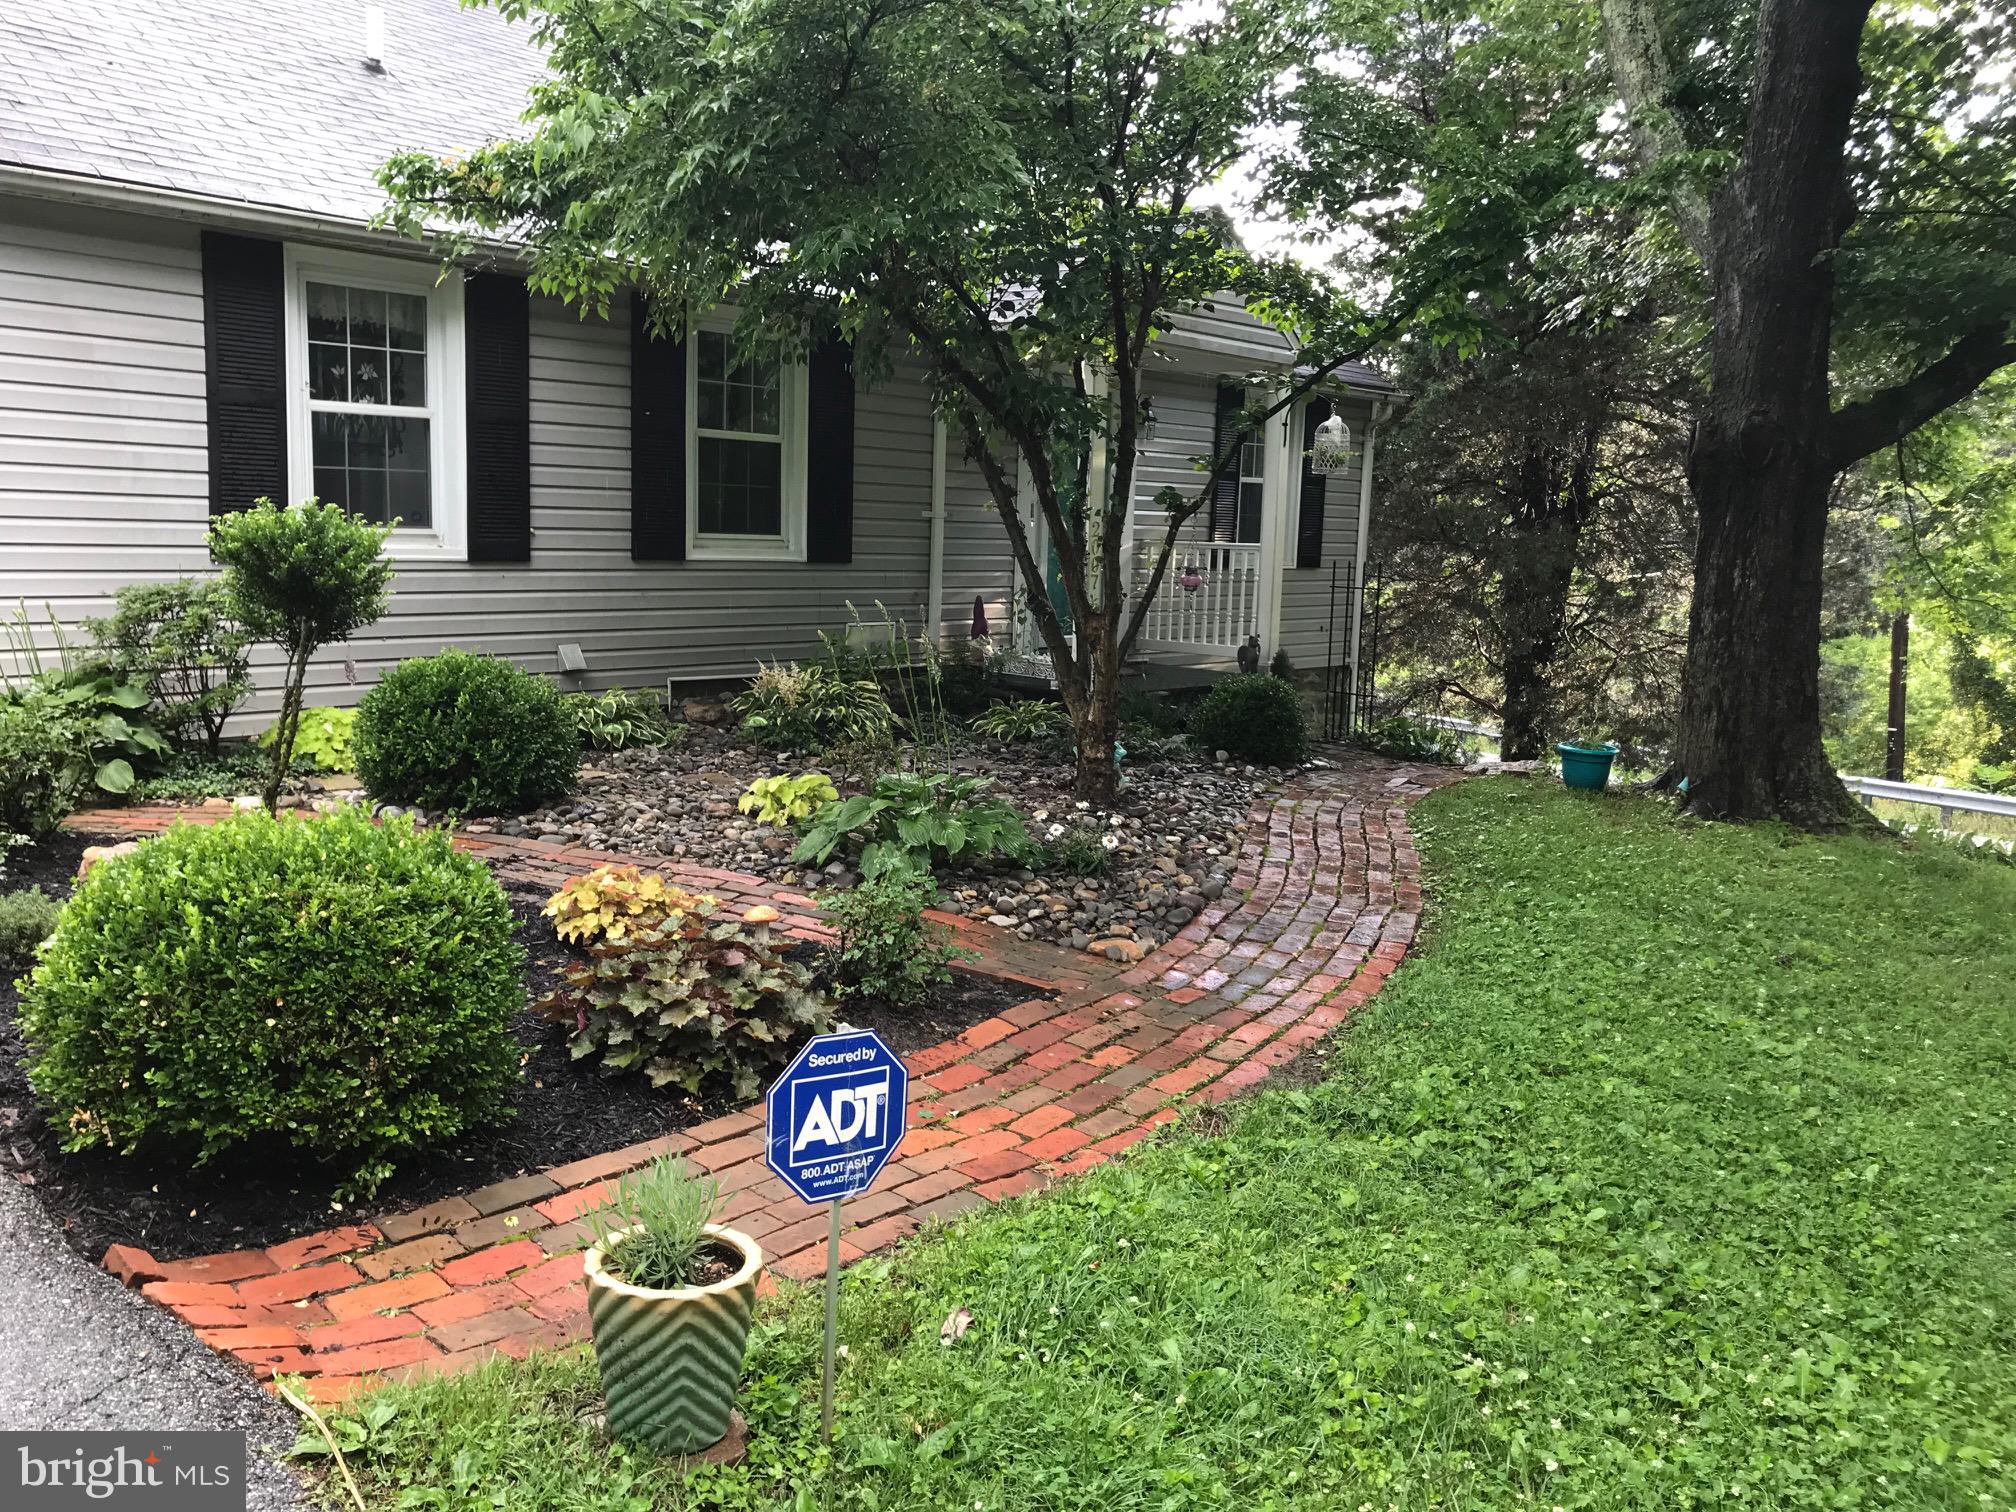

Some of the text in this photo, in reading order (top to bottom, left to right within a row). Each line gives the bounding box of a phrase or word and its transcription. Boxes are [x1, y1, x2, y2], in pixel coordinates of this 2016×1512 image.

[808, 1046, 877, 1068] Secured by
[793, 1081, 888, 1152] ADT
[813, 1172, 864, 1188] www.ADT.com
